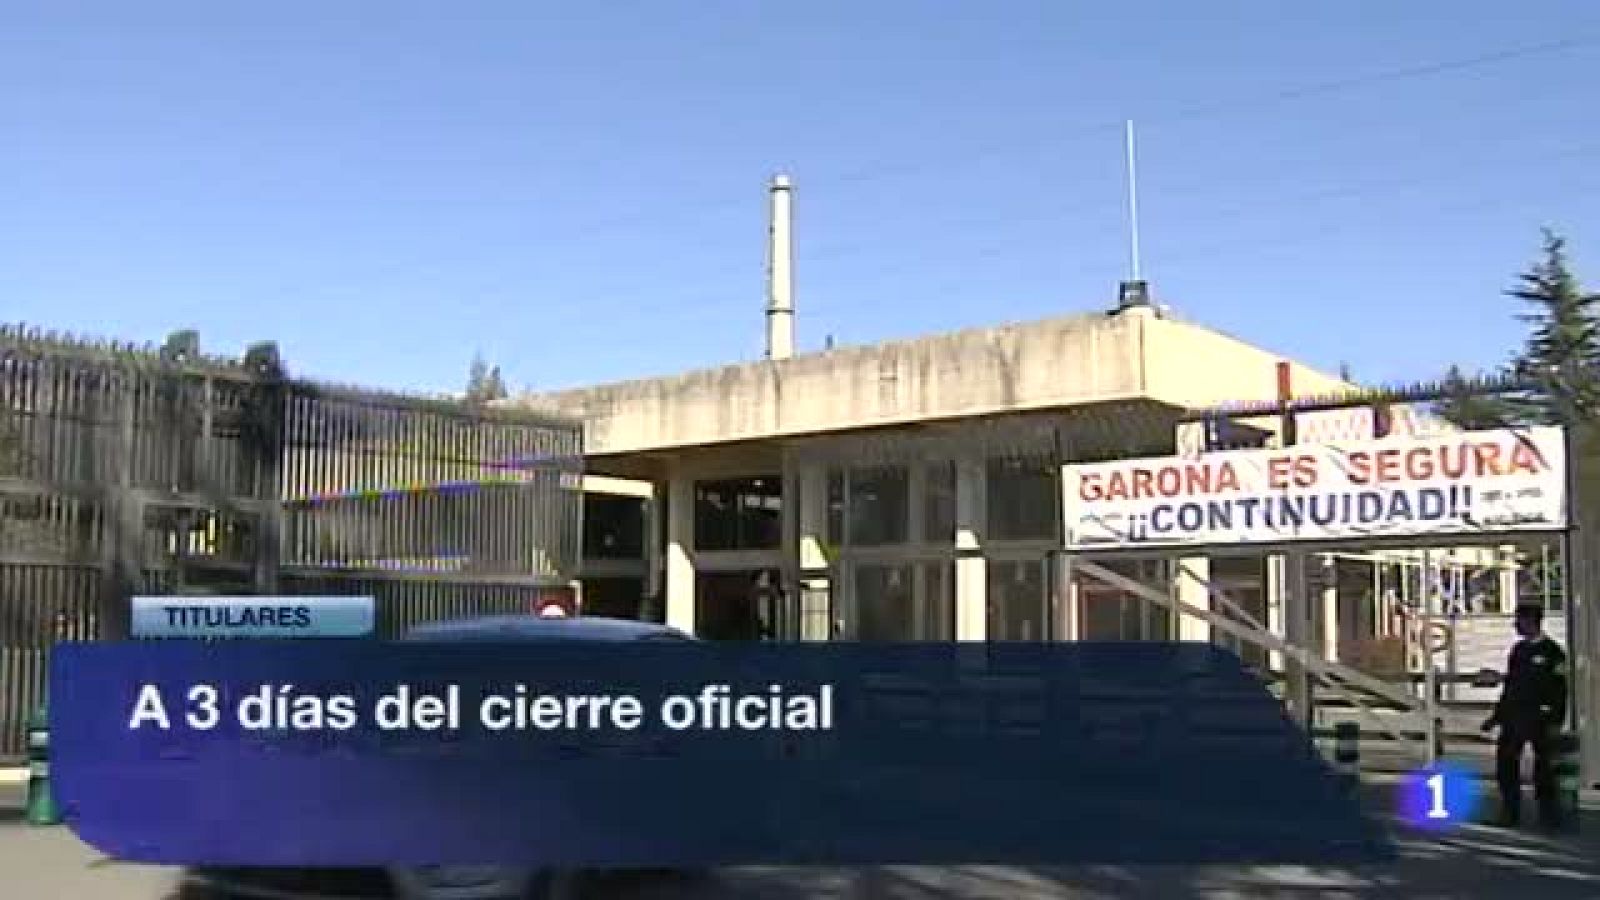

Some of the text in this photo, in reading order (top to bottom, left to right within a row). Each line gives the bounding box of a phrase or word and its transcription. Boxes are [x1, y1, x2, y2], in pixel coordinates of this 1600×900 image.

[1079, 442, 1538, 502] GARONA ES SEGURA
[1128, 484, 1473, 541] ¡¡CONTINUIDAD!!
